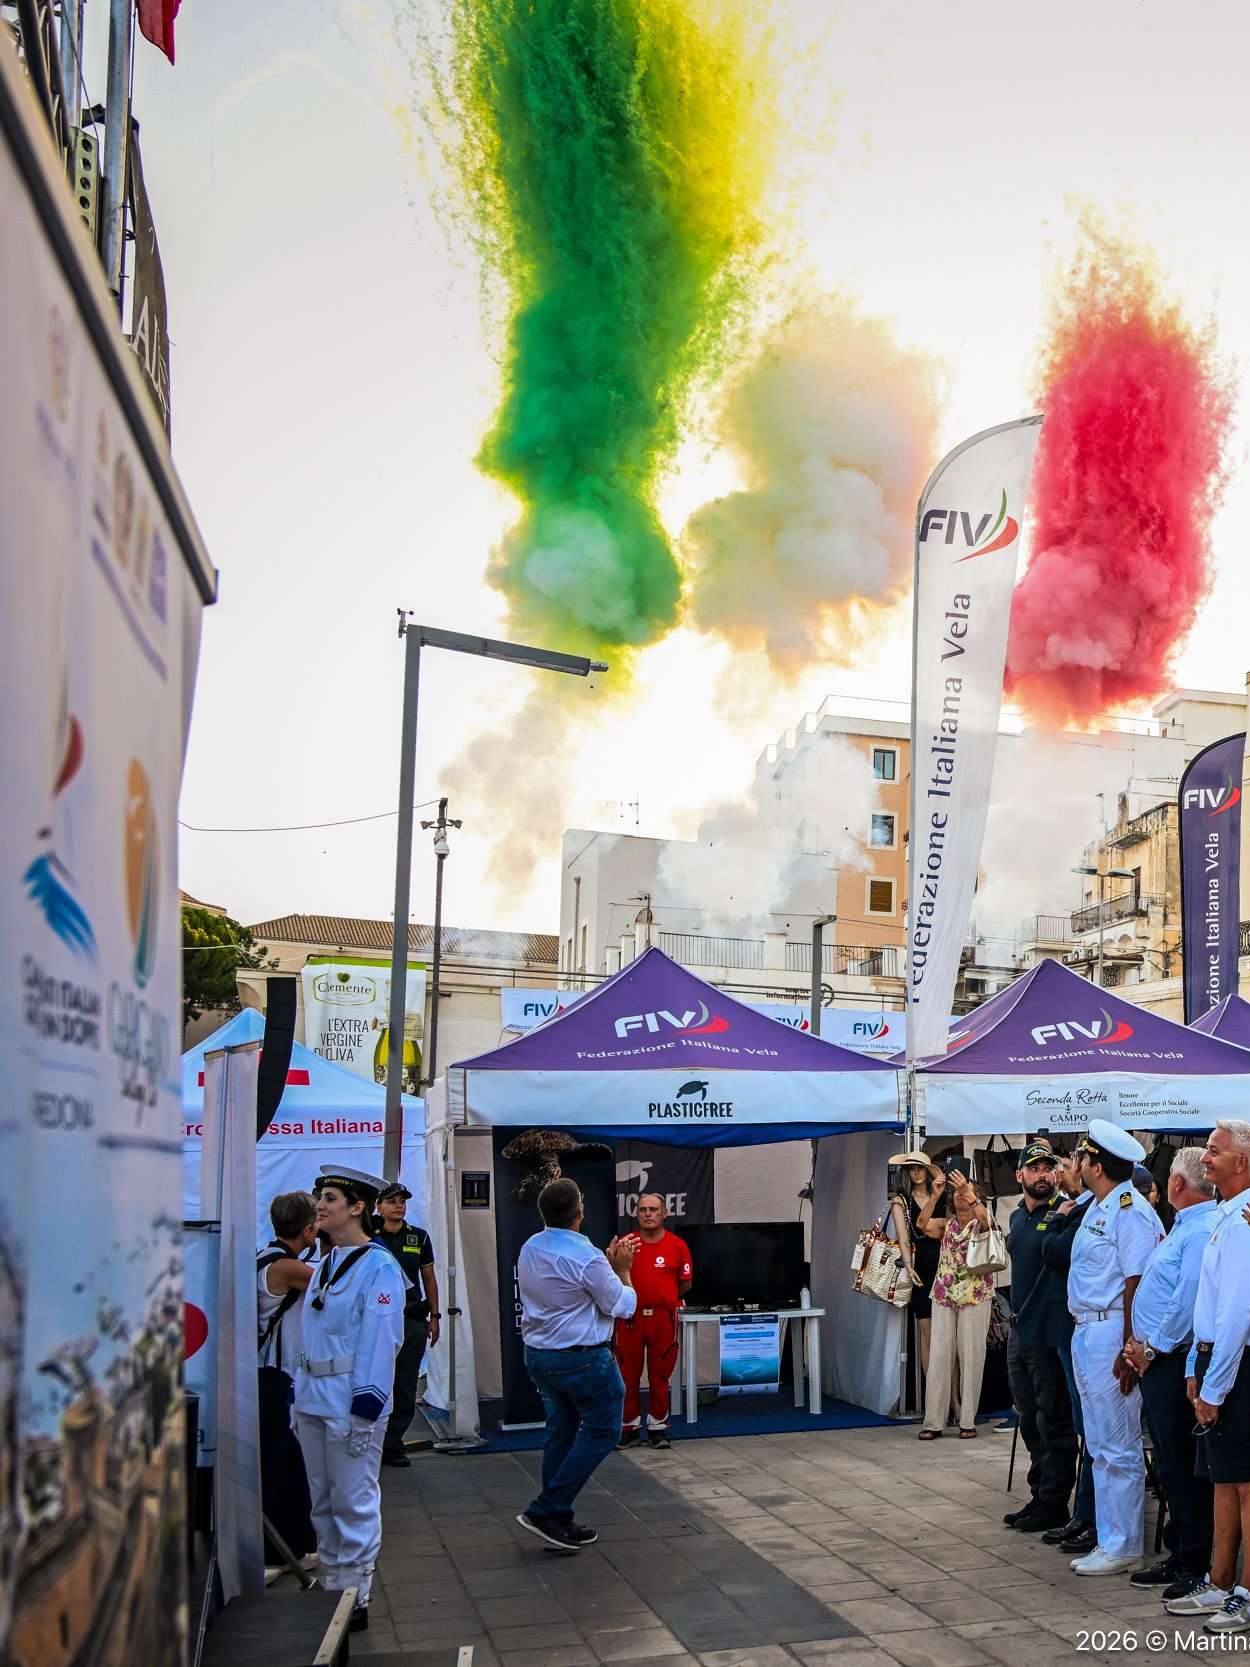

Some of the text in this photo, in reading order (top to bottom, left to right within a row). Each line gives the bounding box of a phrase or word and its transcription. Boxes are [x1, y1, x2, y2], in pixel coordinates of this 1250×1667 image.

[919, 508, 994, 548] FIV
[912, 593, 972, 1004] ederazione Italiana Vela
[1183, 787, 1225, 810] FIV
[1205, 832, 1219, 872] Vela
[1205, 878, 1219, 948] Italiana
[317, 982, 372, 995] Clemente
[523, 1003, 554, 1017] FIV
[328, 1017, 369, 1033] L'EXTRA
[614, 1010, 697, 1038] FIV
[853, 1022, 880, 1036] FIV
[320, 1032, 364, 1048] VERGINE
[1031, 1020, 1102, 1046] FIV
[576, 1039, 779, 1059] Federazione Italiana Vela
[1008, 1048, 1185, 1064] Federazione Italiana Vela
[1025, 1088, 1109, 1106] Seconda Rotta
[1119, 1100, 1150, 1109] Eccellenze
[1150, 1101, 1161, 1109] per
[1168, 1099, 1189, 1107] Sociale
[648, 1102, 734, 1119] PLASTICFREE
[1050, 1113, 1089, 1123] CAMPO
[1178, 1108, 1201, 1116] Sociale
[266, 1118, 383, 1135] ssa Italiana
